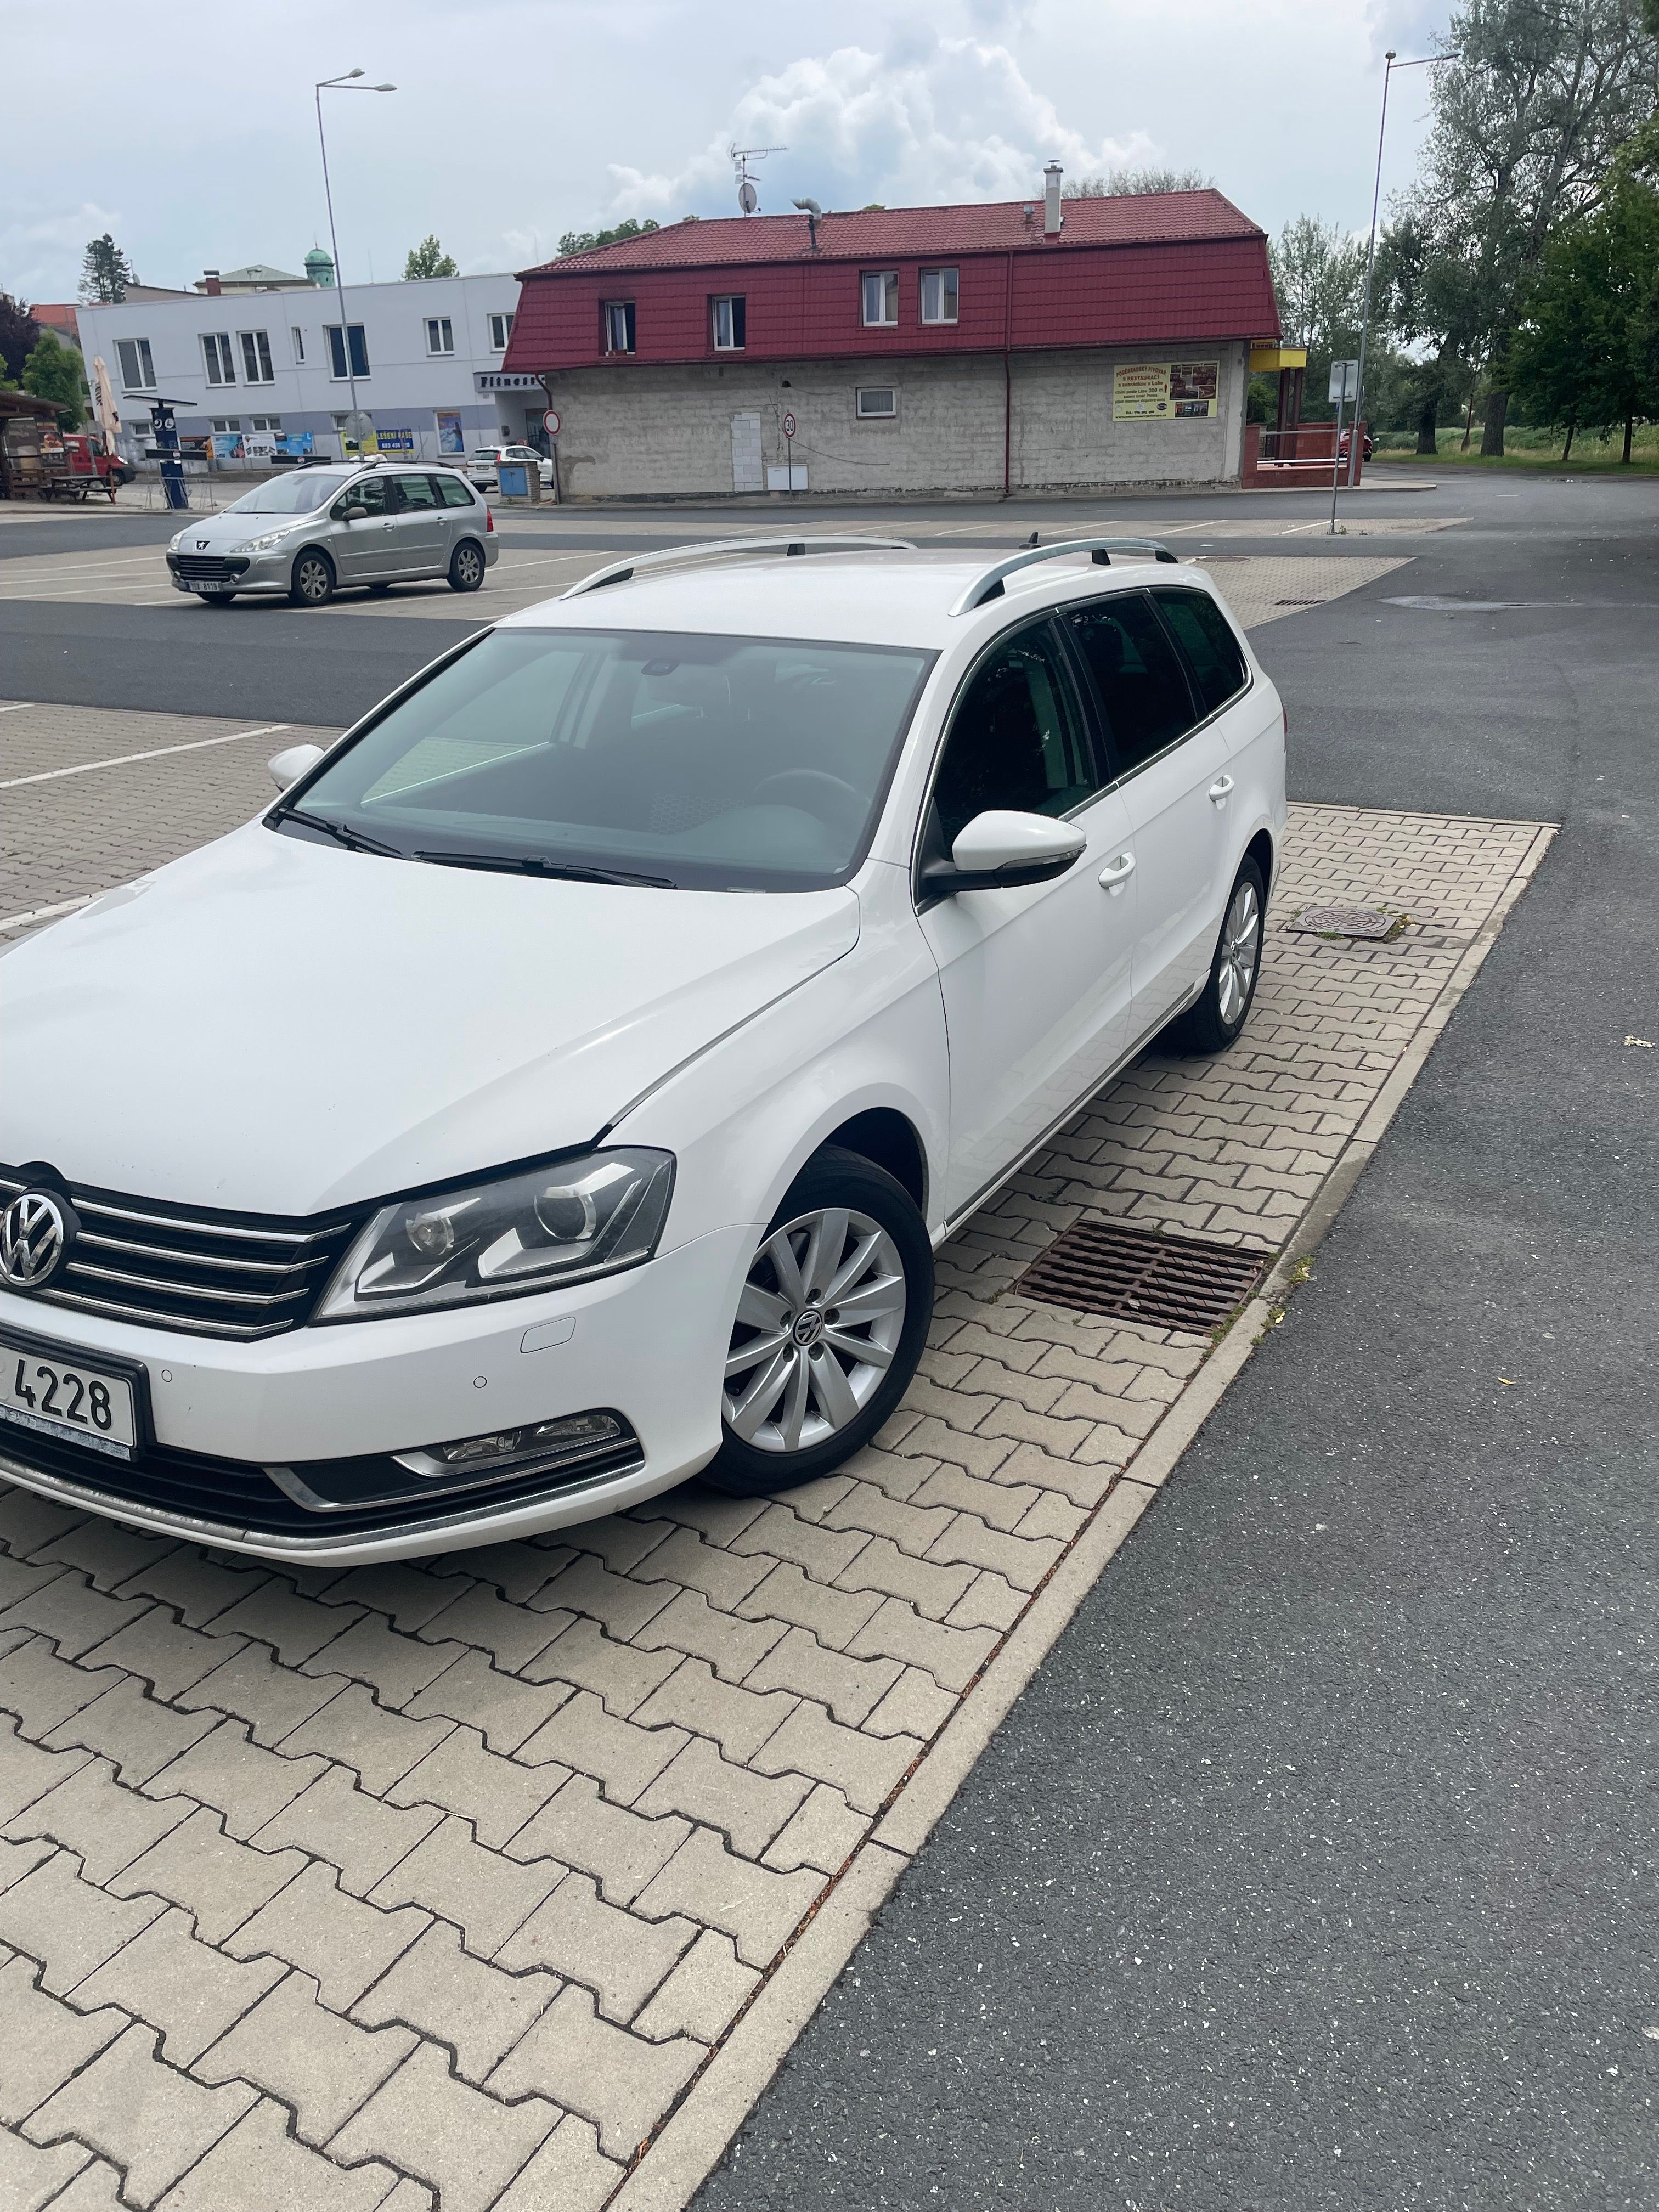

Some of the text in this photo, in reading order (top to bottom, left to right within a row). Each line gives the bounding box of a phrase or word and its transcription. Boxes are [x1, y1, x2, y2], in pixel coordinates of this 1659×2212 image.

[1148, 366, 1166, 376] PIVOVAR
[481, 376, 535, 387] Fitness
[786, 420, 793, 431] 30
[15, 1359, 112, 1430] 4228
